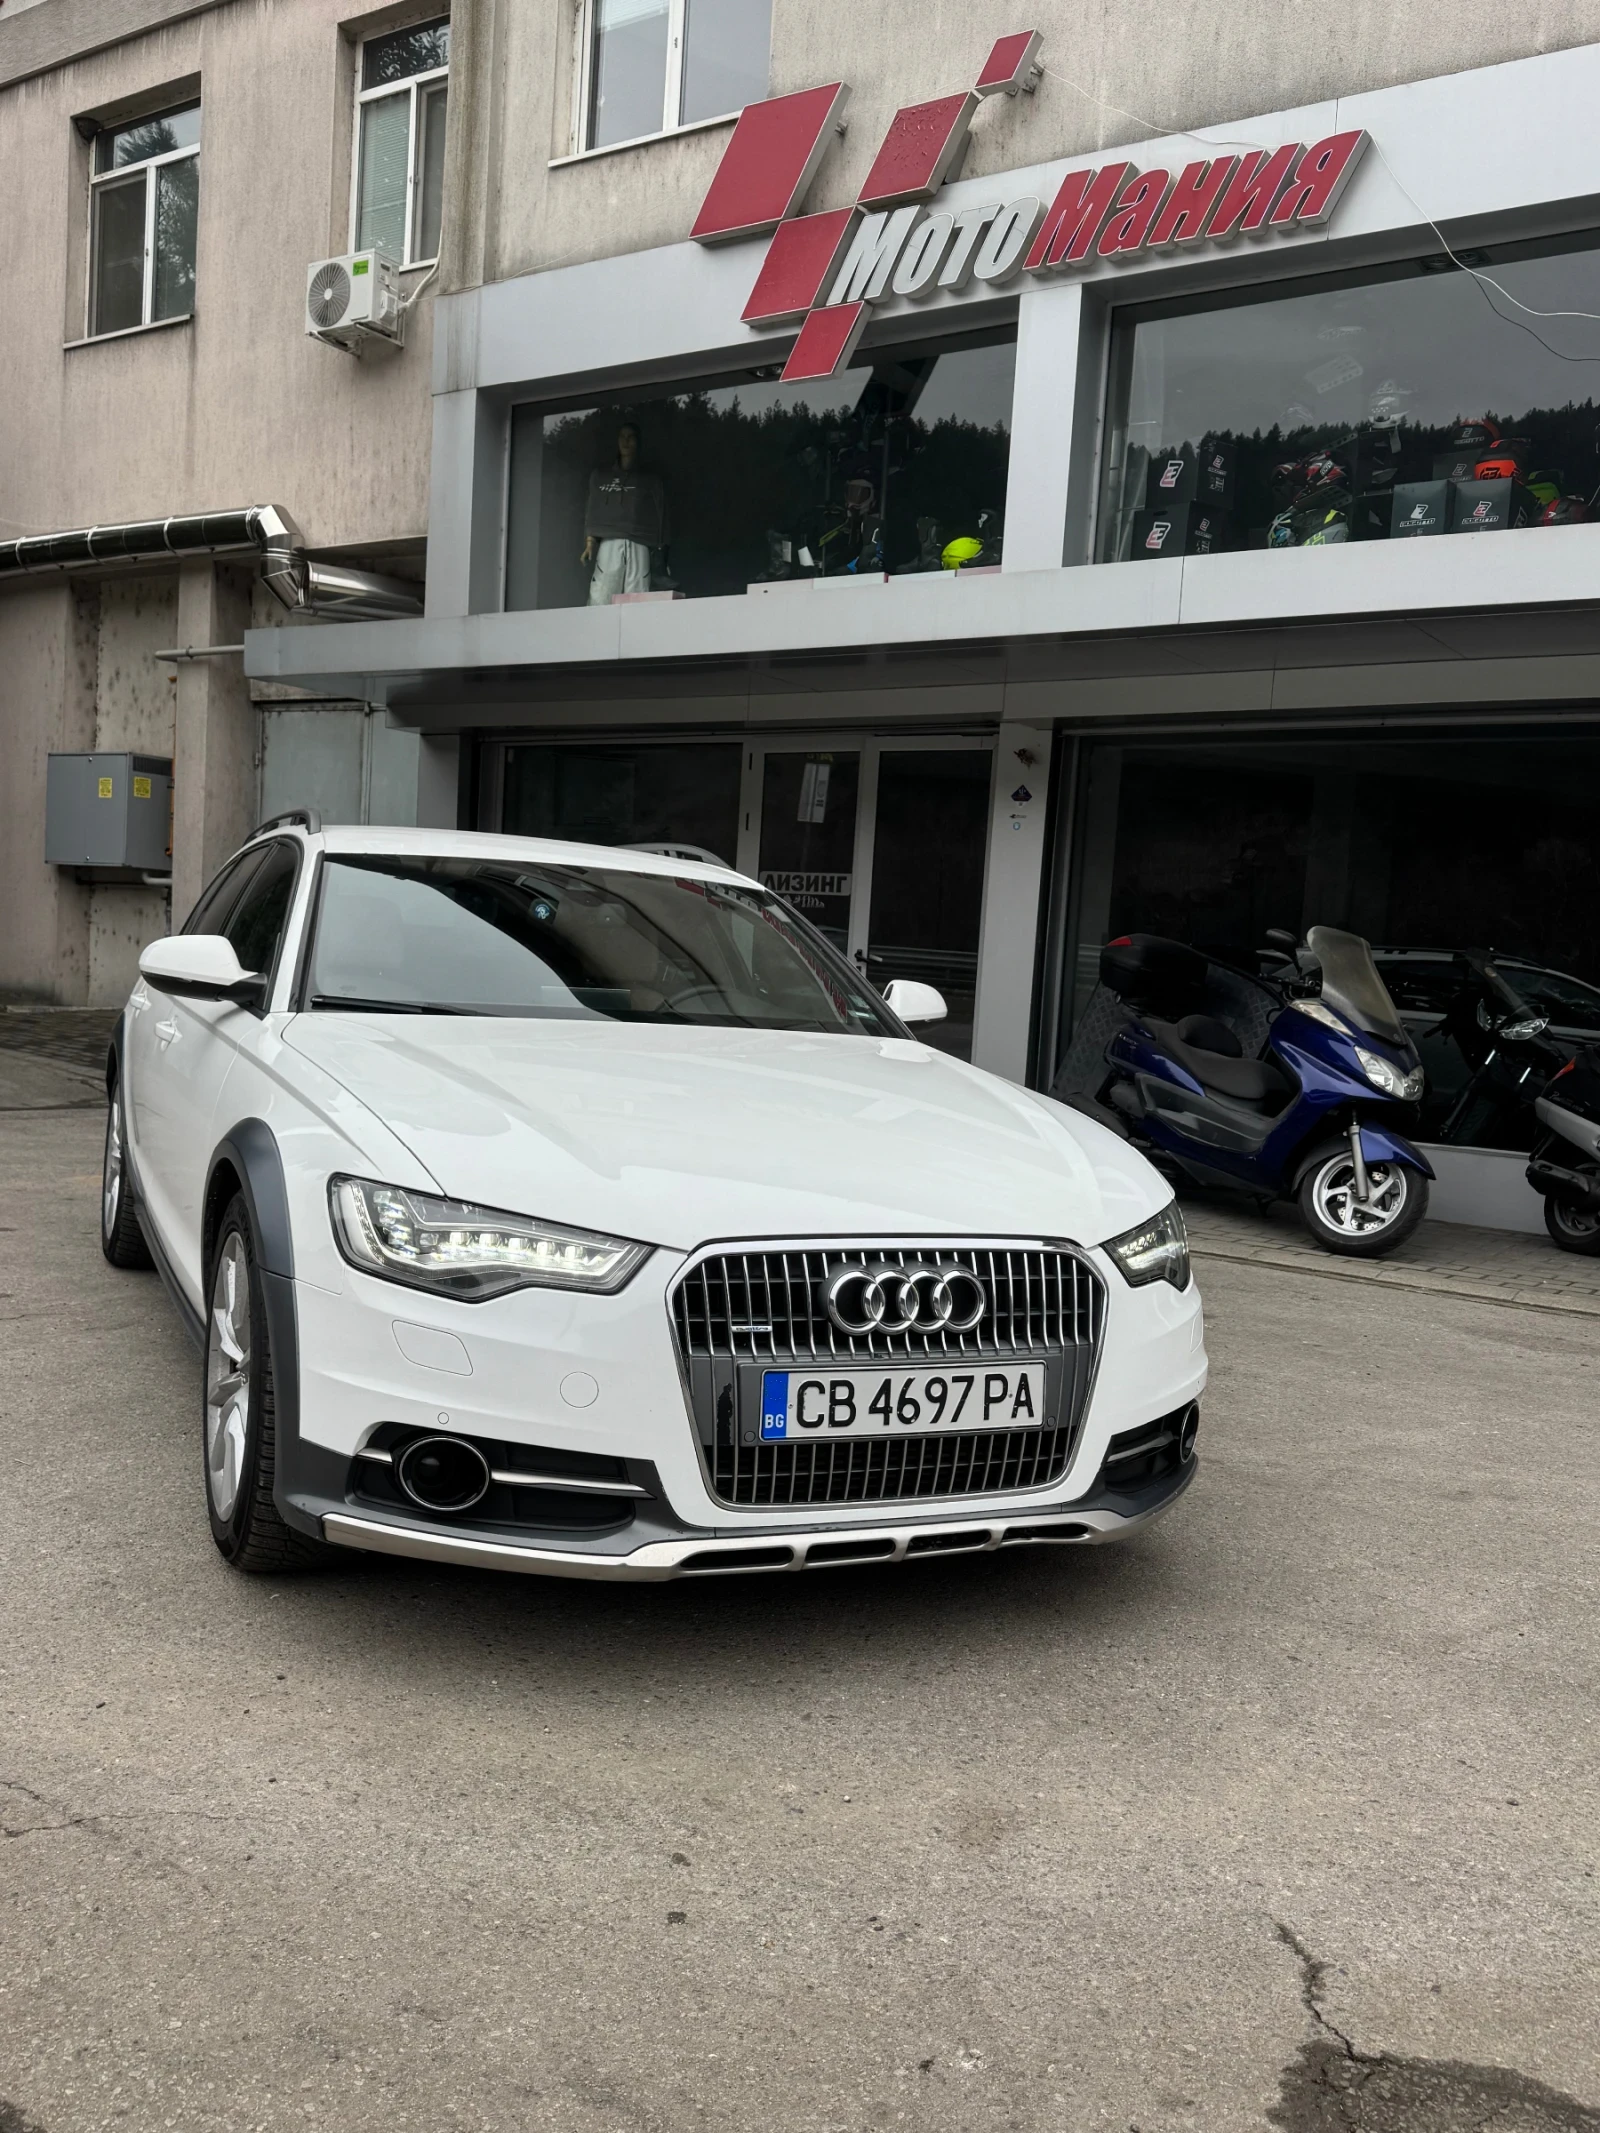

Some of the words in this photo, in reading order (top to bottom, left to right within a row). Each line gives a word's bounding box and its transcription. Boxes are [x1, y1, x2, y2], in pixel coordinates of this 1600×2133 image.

[764, 873, 847, 893] ЛИЗИНГ
[796, 1380, 856, 1428] CB
[868, 1375, 975, 1426] 4697
[983, 1372, 1034, 1421] PA
[764, 1414, 785, 1429] BG
